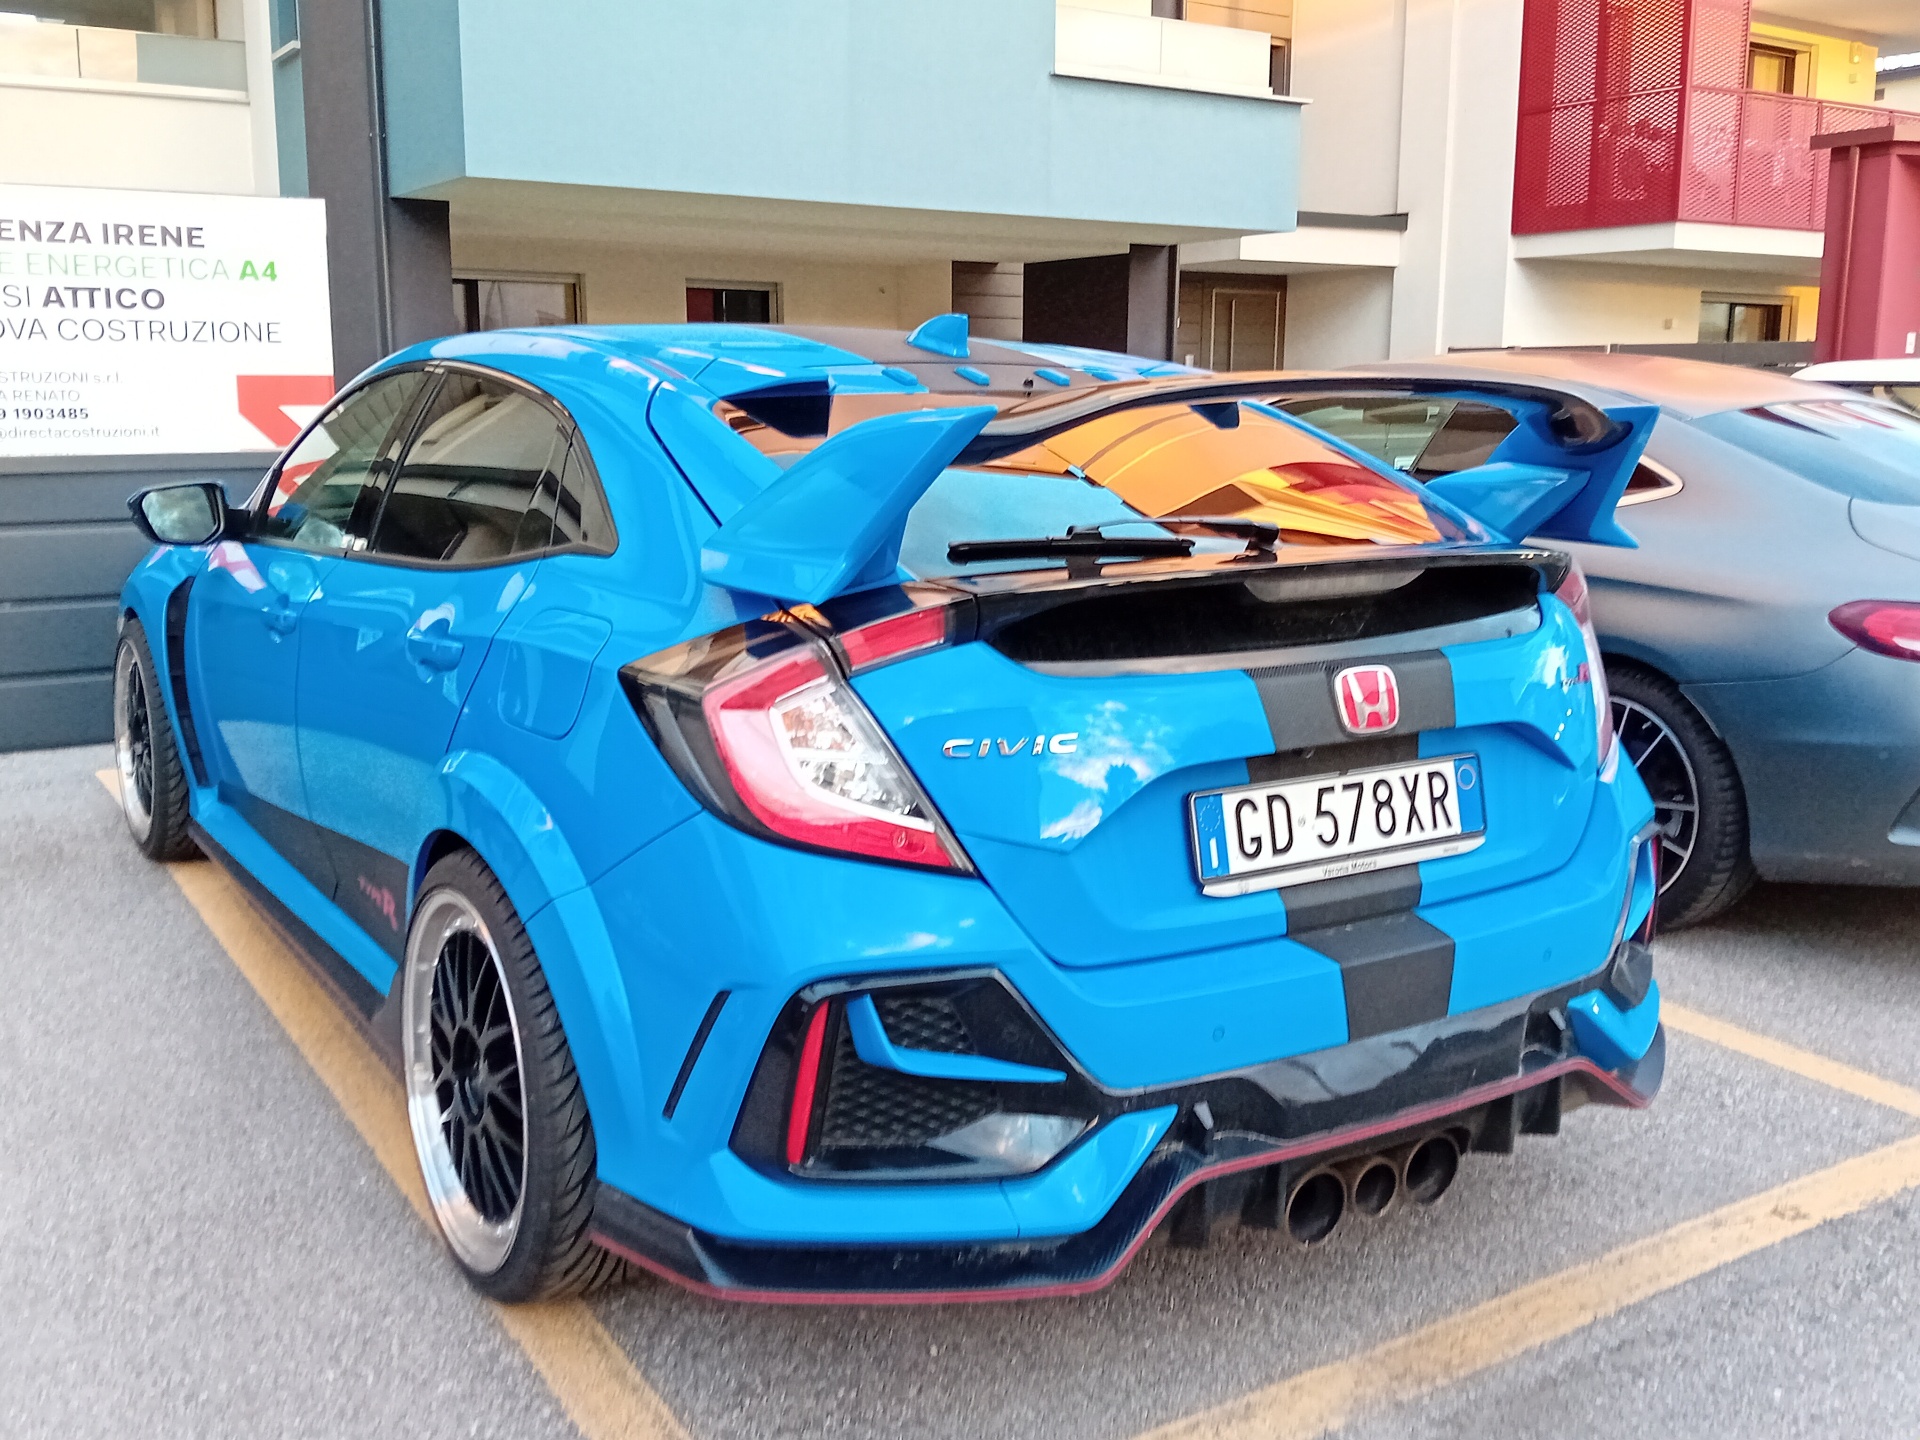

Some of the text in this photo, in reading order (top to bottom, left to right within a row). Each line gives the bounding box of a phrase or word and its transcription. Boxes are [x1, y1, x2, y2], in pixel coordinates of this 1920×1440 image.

[0, 218, 206, 249] ENZA IRENE
[26, 252, 230, 281] ENERGETICA
[239, 259, 278, 282] A4
[2, 284, 166, 311] SI ATTICO
[0, 317, 282, 344] VA COSTRUZIONE
[12, 389, 81, 402] RENATO
[13, 407, 89, 420] 1903485
[942, 732, 1079, 758] CIVIC
[1234, 771, 1452, 862] GD 578XR
